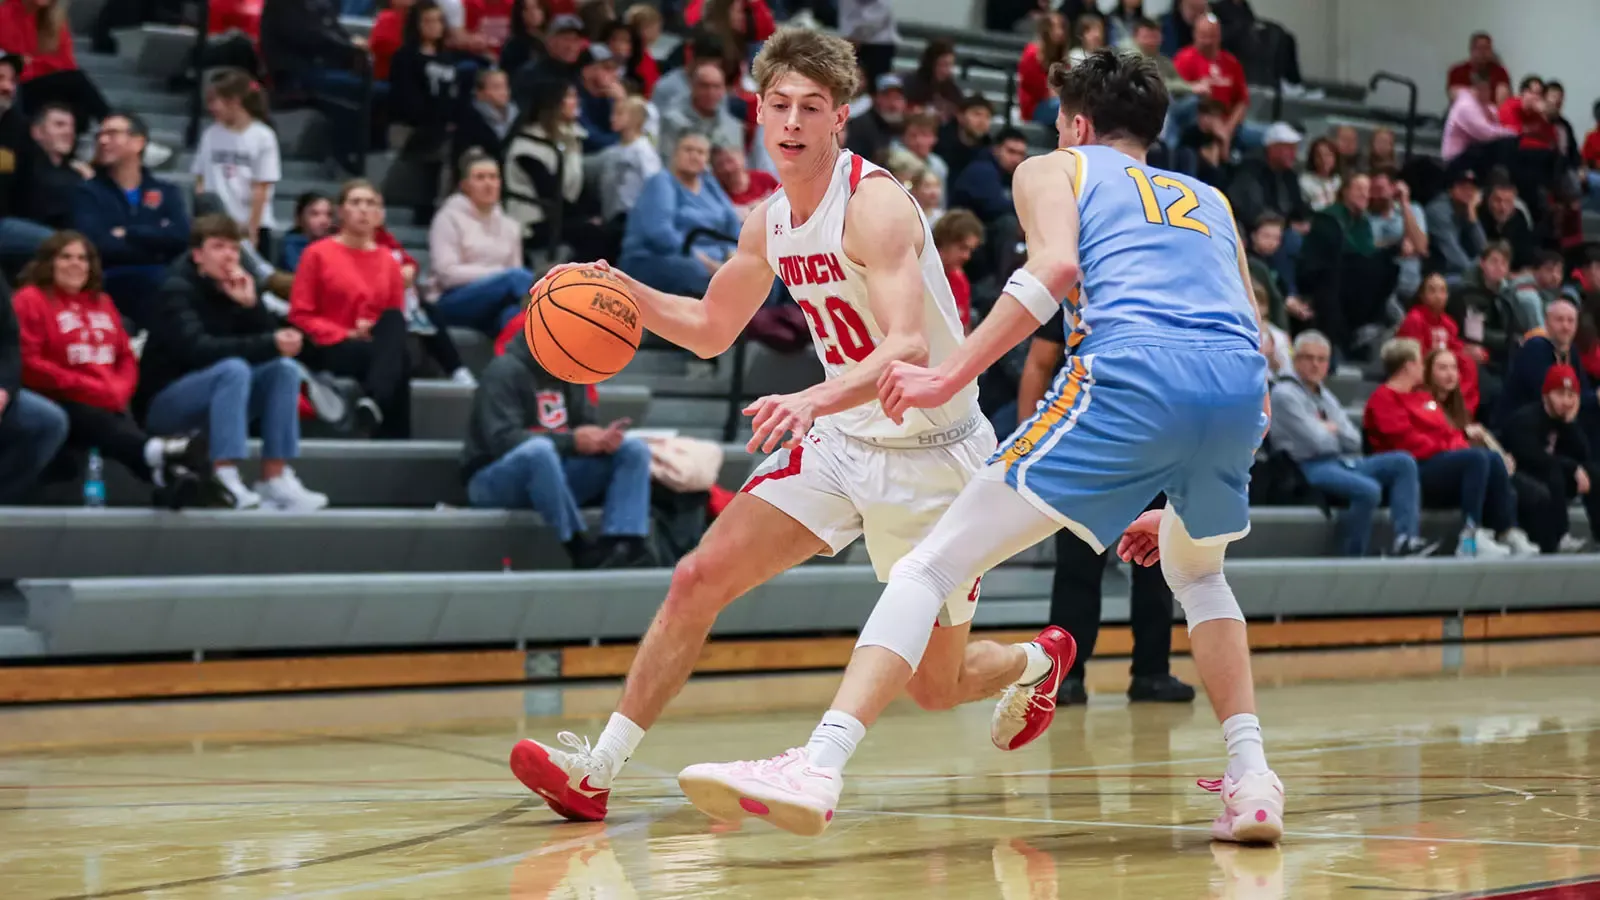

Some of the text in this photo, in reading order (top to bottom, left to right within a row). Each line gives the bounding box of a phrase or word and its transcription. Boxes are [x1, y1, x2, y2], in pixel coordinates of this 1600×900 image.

[1124, 166, 1211, 238] 12
[778, 252, 847, 287] DUTCH
[797, 296, 877, 365] 20
